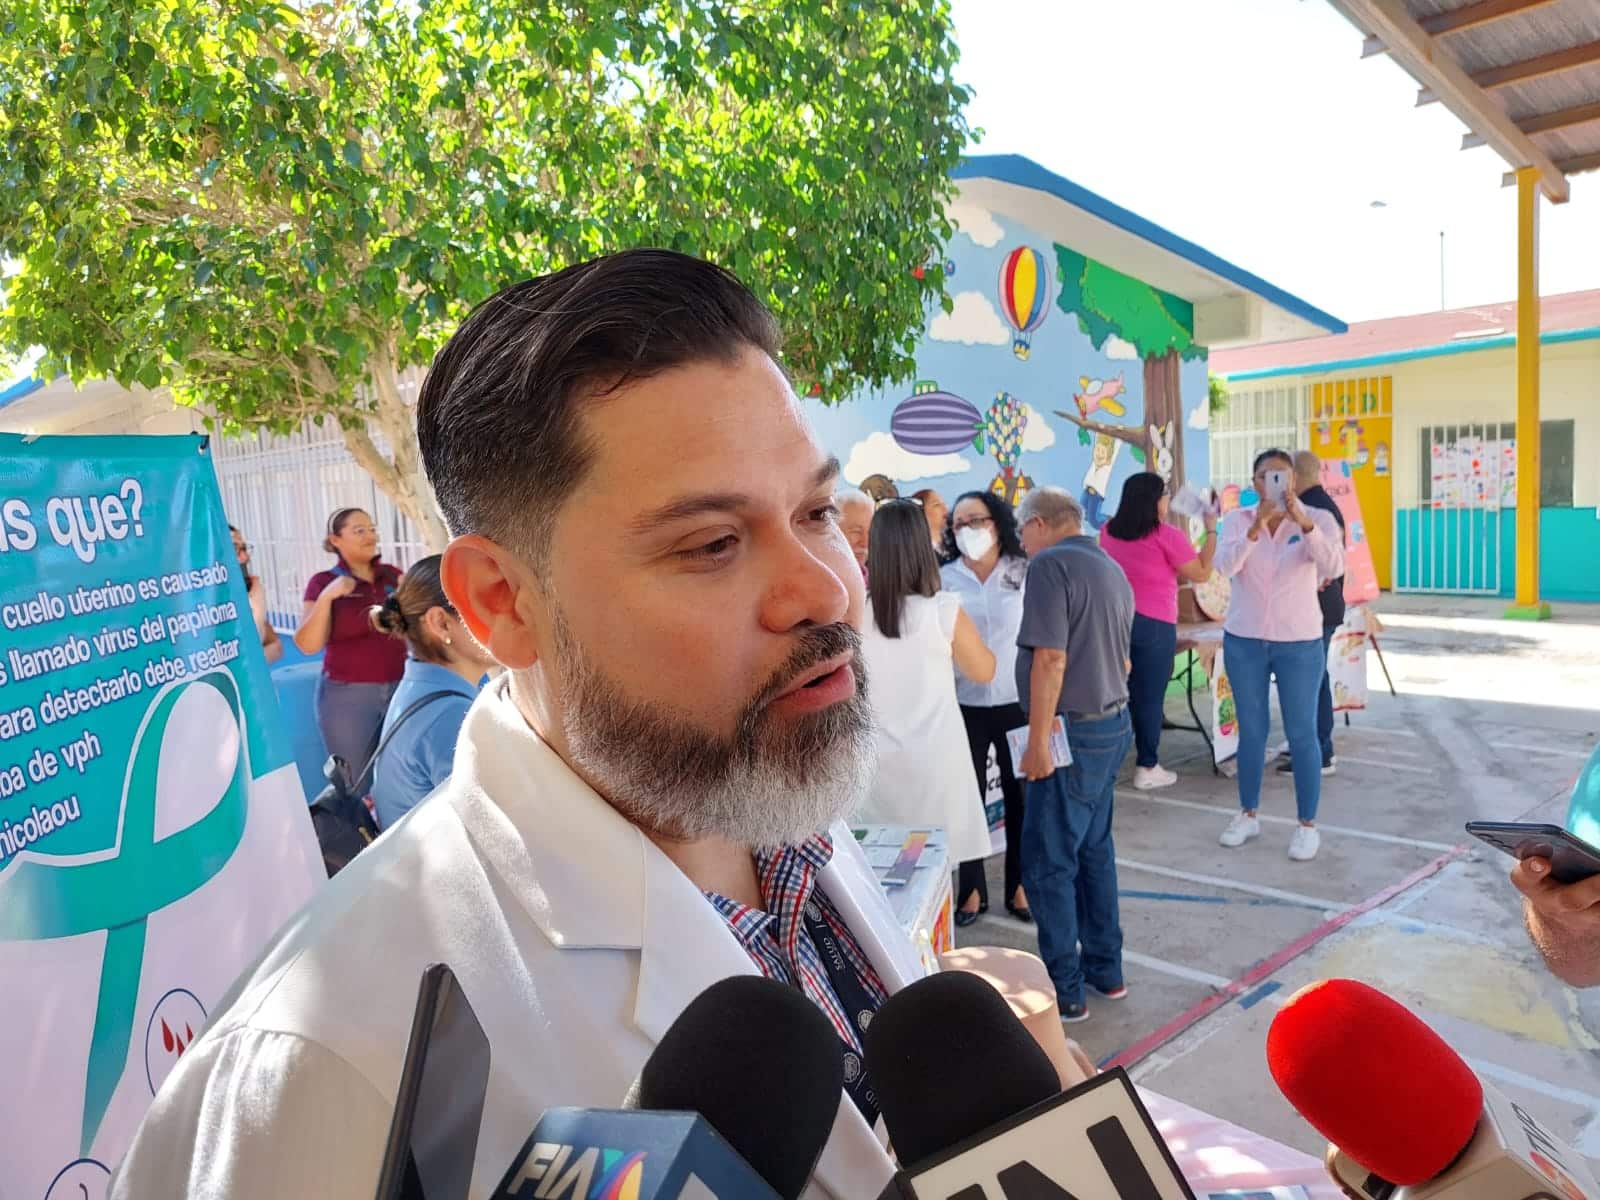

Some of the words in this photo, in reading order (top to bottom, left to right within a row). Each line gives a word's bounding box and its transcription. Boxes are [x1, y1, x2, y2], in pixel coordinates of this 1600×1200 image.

[47, 478, 145, 564] que?
[2, 592, 66, 631] cuello
[70, 580, 136, 614] uterino
[138, 577, 159, 601] es
[161, 562, 229, 595] causado
[8, 635, 91, 682] llamado
[93, 625, 138, 657] virus
[140, 614, 166, 644] del
[168, 601, 238, 644] papiloma
[40, 668, 142, 724] detectarlo
[144, 656, 187, 688] debe
[189, 638, 240, 672] realizar
[28, 750, 59, 782] de
[61, 730, 102, 773] vph
[823, 936, 843, 971] SALUD
